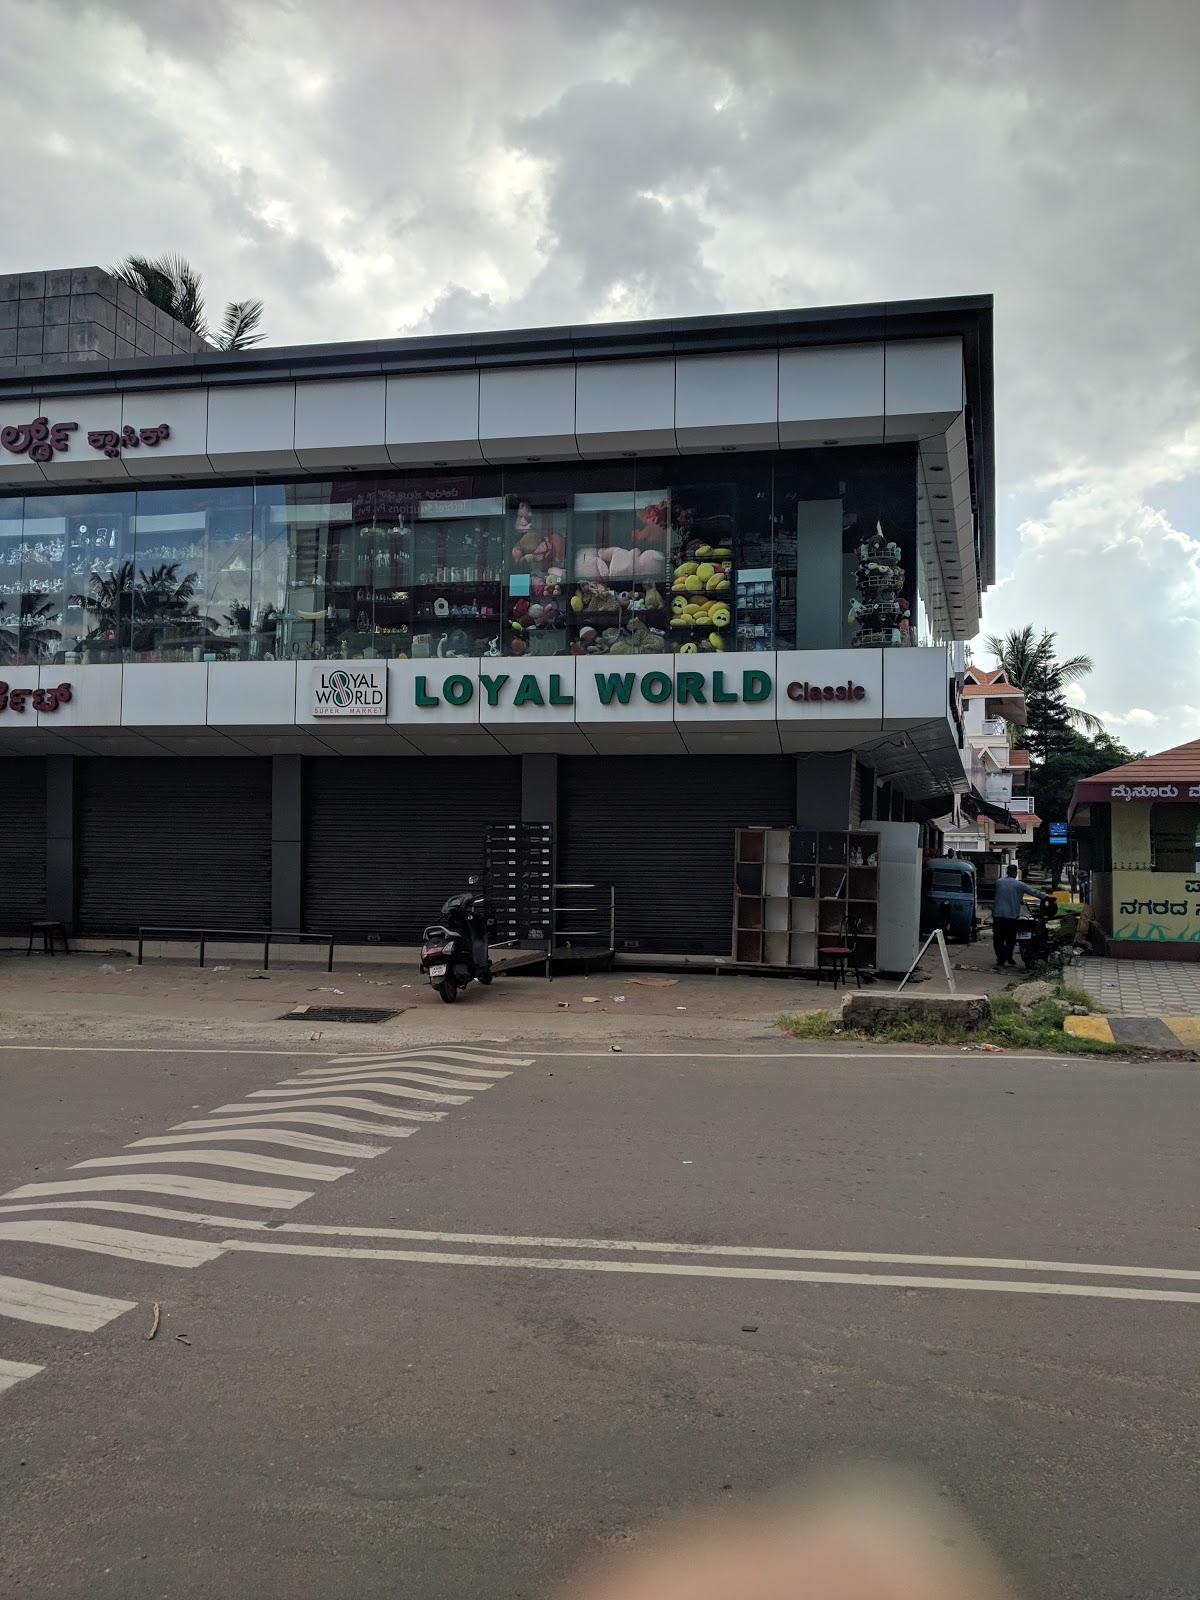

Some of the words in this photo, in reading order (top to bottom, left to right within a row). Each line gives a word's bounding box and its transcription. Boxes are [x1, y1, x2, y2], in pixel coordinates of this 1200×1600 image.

[415, 673, 574, 706] LOYAL
[594, 670, 772, 704] WORLD
[786, 680, 867, 702] Classic
[1110, 783, 1179, 802] ಮೈಸೂರು
[1120, 898, 1189, 916] ನಗರದ
